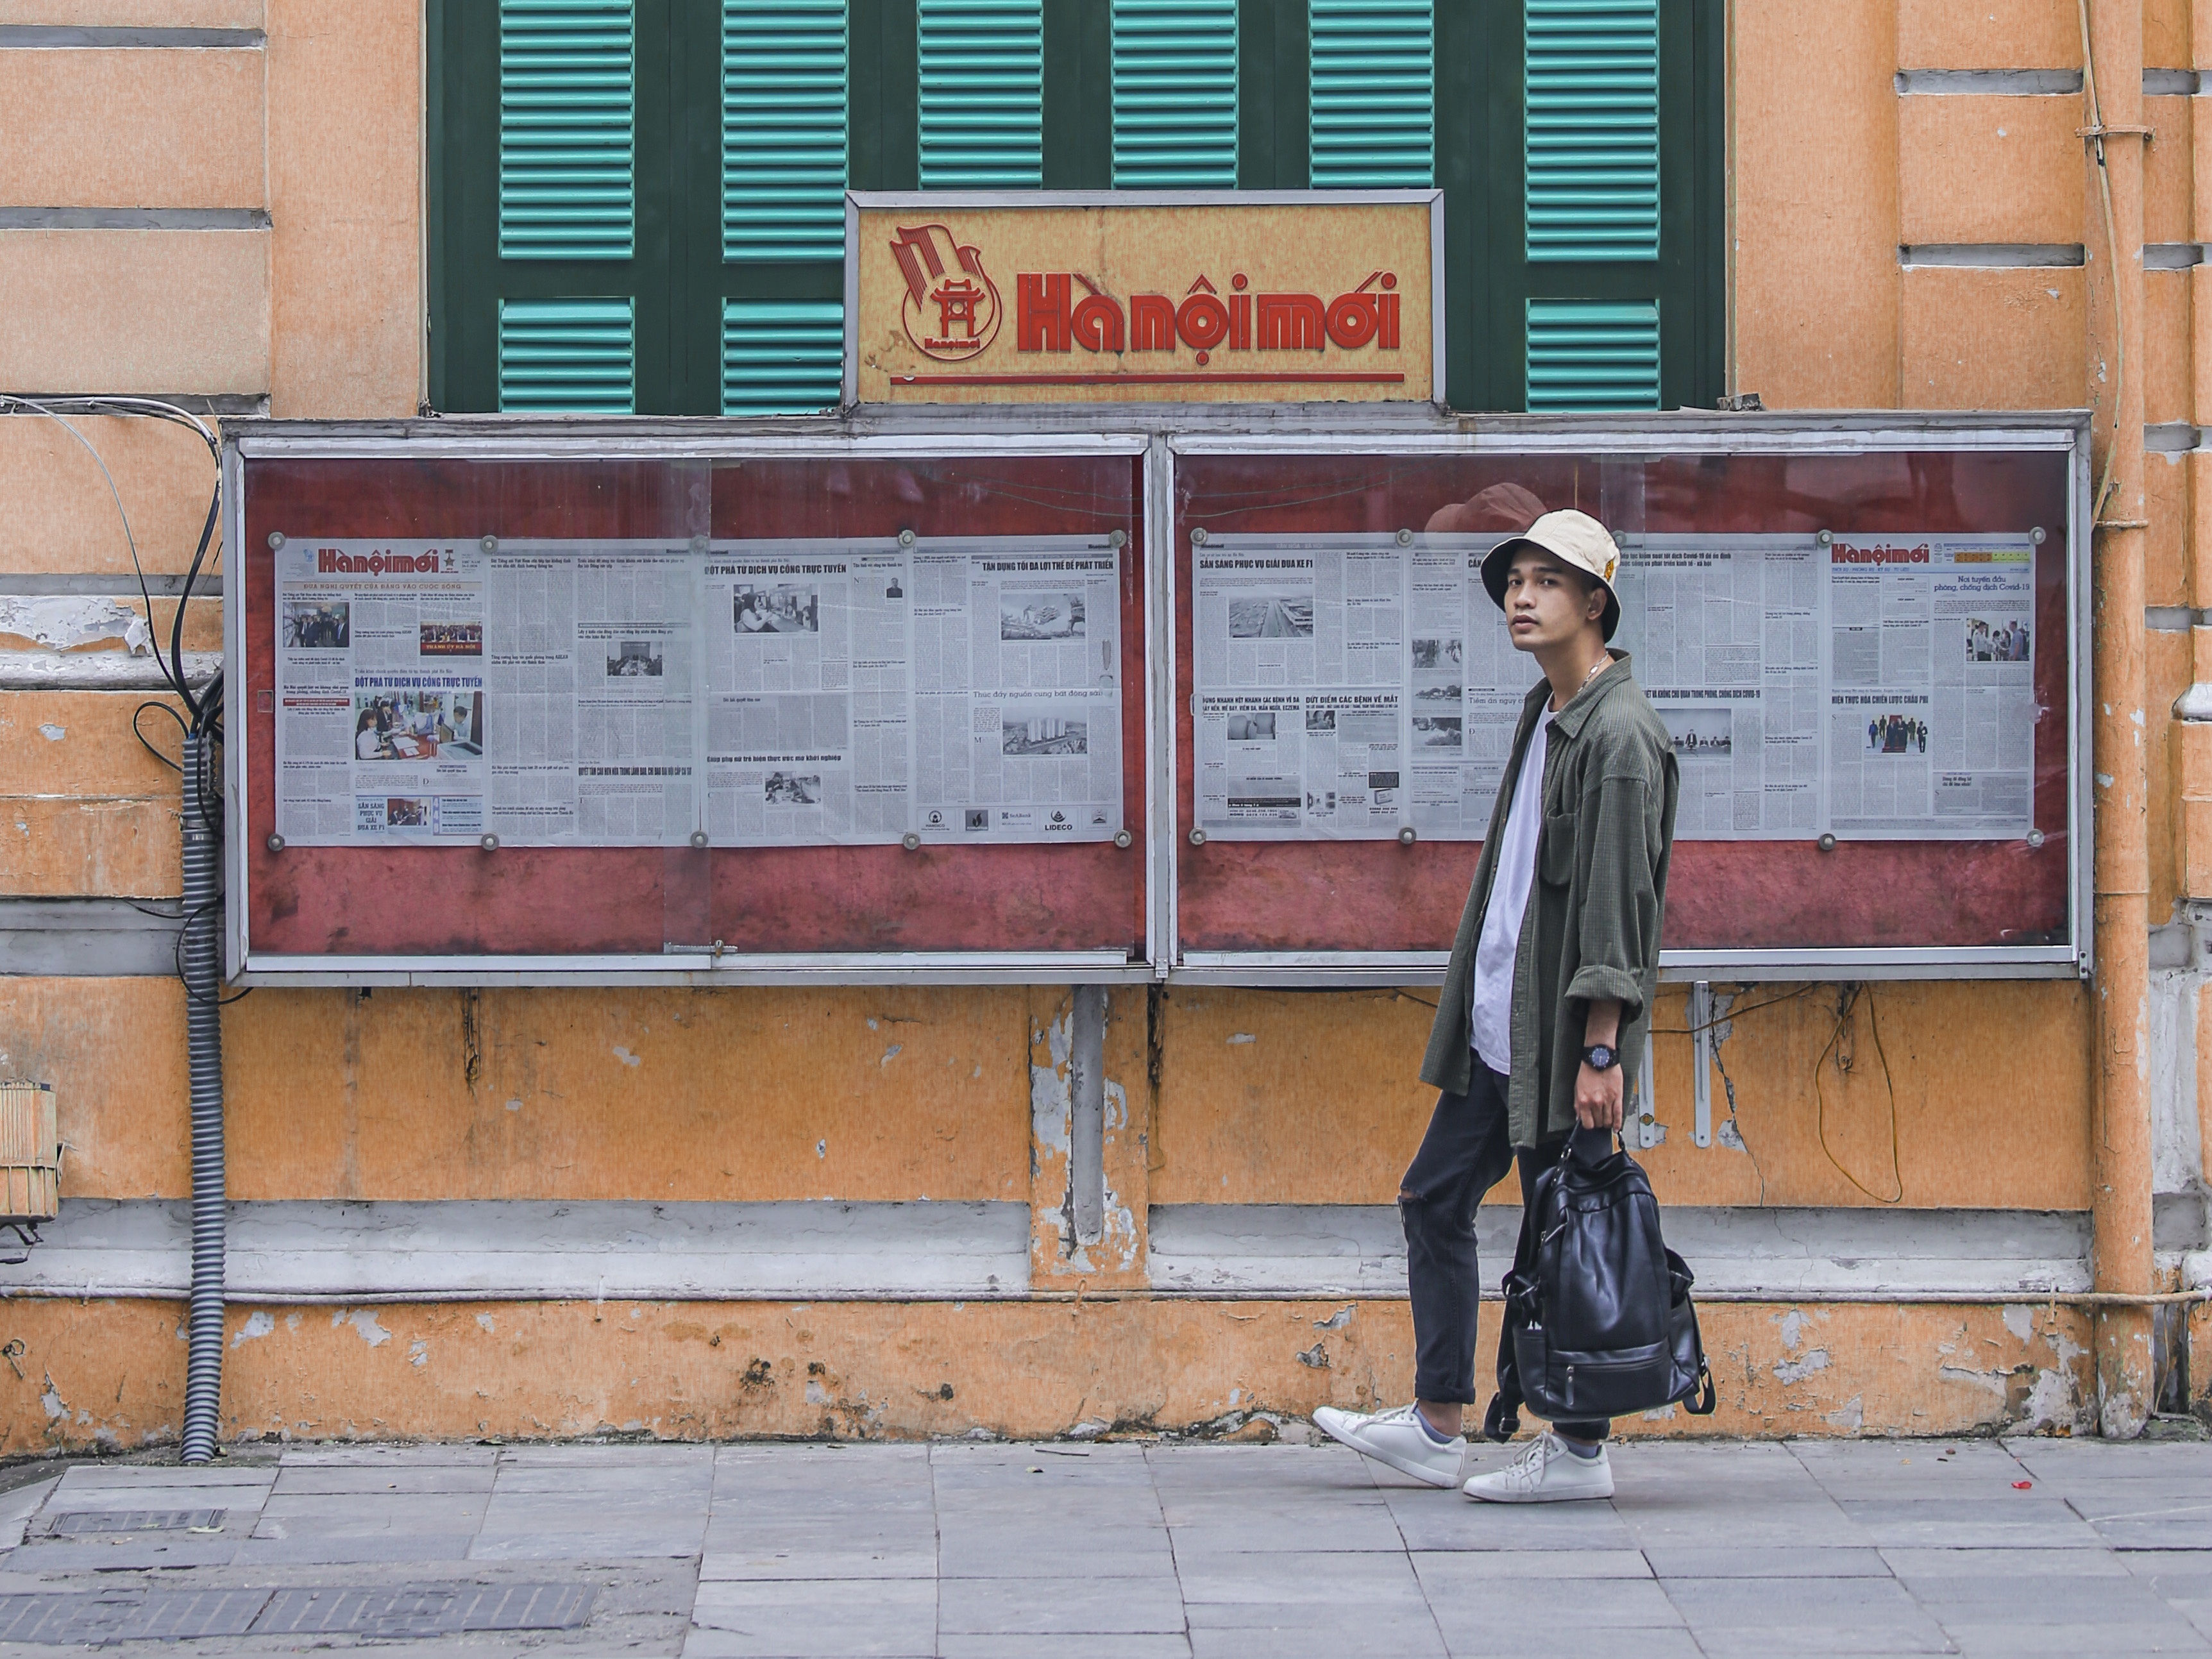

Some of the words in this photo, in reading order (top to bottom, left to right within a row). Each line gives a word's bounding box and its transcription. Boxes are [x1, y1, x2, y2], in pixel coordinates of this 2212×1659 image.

[1017, 271, 1400, 366] Hànộimới
[1832, 544, 1929, 566] Hànộimới
[318, 549, 439, 577] Hànộimới
[704, 564, 718, 575] ĐỘT
[721, 564, 735, 574] PHÁ
[738, 564, 747, 574] TỪ
[748, 566, 766, 575] DỊCH
[768, 566, 778, 575] VỤ
[780, 564, 800, 573] CÔNG
[802, 566, 822, 574] TRỰC
[824, 562, 847, 573] TUYẾN
[983, 560, 995, 572] TẬN
[997, 562, 1016, 572] DỤNG
[1017, 559, 1028, 570] TỐI
[1029, 562, 1038, 570] ĐA
[1040, 562, 1051, 571] LỢI
[1052, 559, 1064, 570] THẾ
[1066, 559, 1074, 569] ĐỂ
[1076, 560, 1092, 569] PHÁT
[1094, 559, 1113, 569] TRIỂN
[1200, 558, 1213, 568] SẴN
[1215, 559, 1233, 568] SÀNG
[1235, 560, 1253, 569] PHỤC
[1255, 560, 1264, 569] VỤ
[1266, 558, 1280, 568] GIẢI
[1971, 576, 1991, 584] tuyến
[355, 676, 368, 688] ĐỘT
[369, 676, 383, 687] PHÁ
[385, 676, 393, 687] TỪ
[394, 677, 410, 688] DỊCH
[412, 677, 421, 688] VỤ
[423, 676, 441, 687] CÔNG
[443, 677, 460, 688] TRỰC
[462, 675, 482, 687] TUYẾN
[1320, 695, 1337, 703] ĐIỂM
[1355, 695, 1372, 705] BỆNH
[1374, 694, 1381, 702] VỀ
[1384, 694, 1398, 702] MẮT
